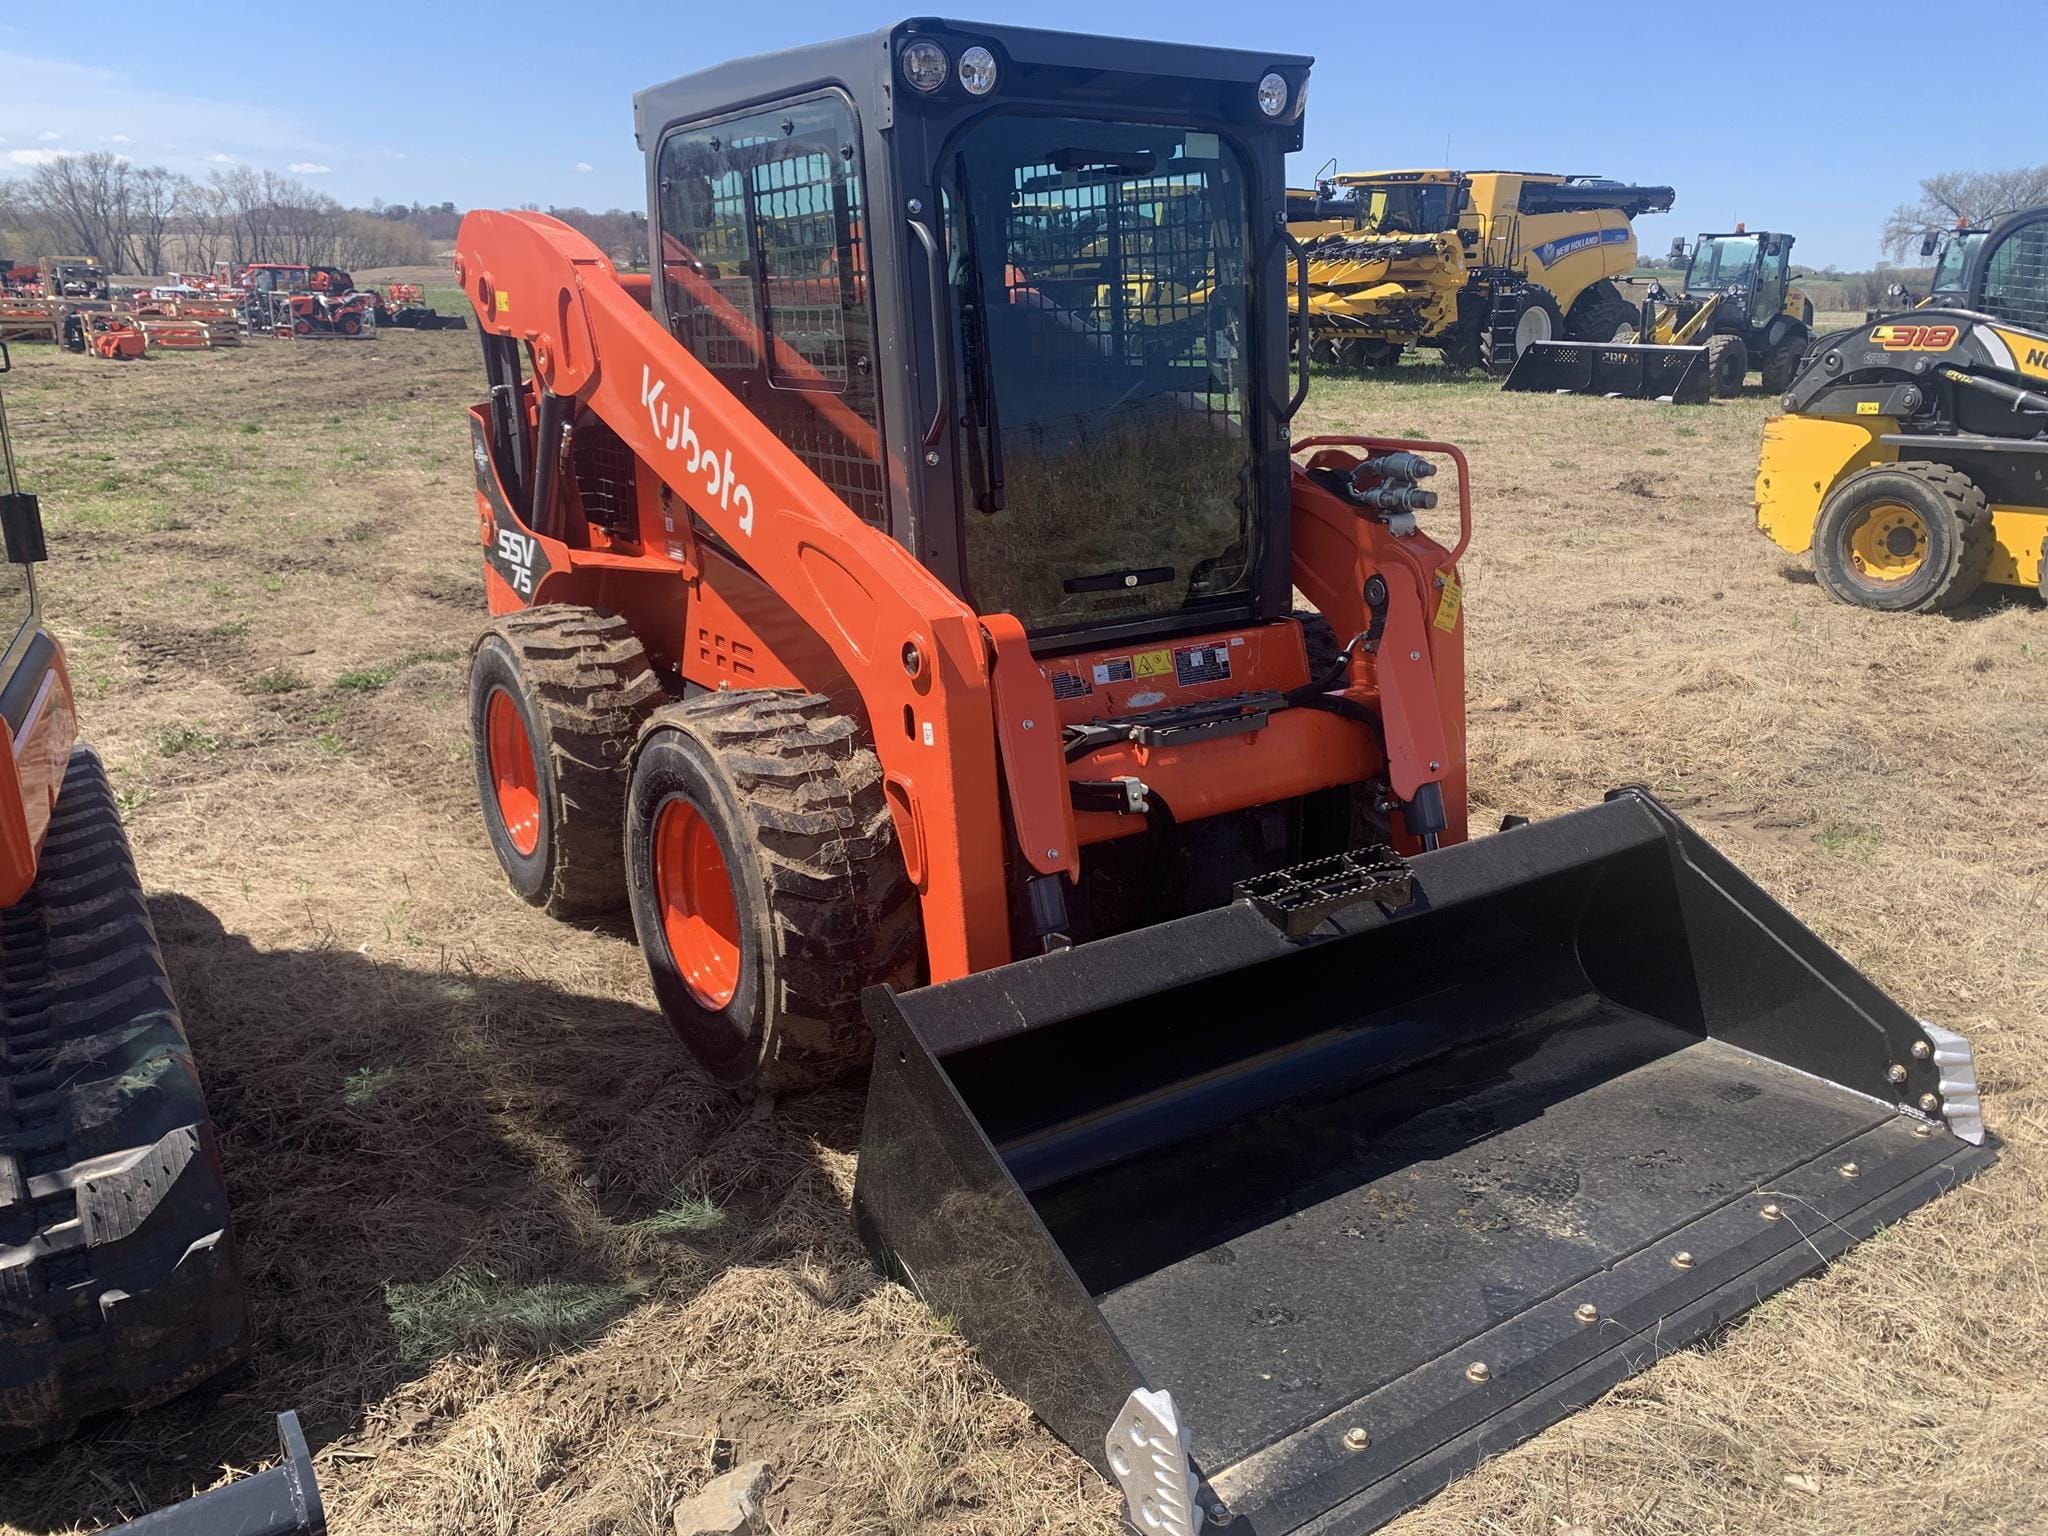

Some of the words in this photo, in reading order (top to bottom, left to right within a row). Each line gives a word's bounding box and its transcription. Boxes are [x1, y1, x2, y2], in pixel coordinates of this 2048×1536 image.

[1555, 243, 1571, 258] NEW
[1570, 236, 1599, 252] HOLLAND
[1869, 325, 1959, 351] L318
[641, 364, 754, 538] Kubota
[498, 529, 535, 567] SSV
[511, 565, 532, 594] 75
